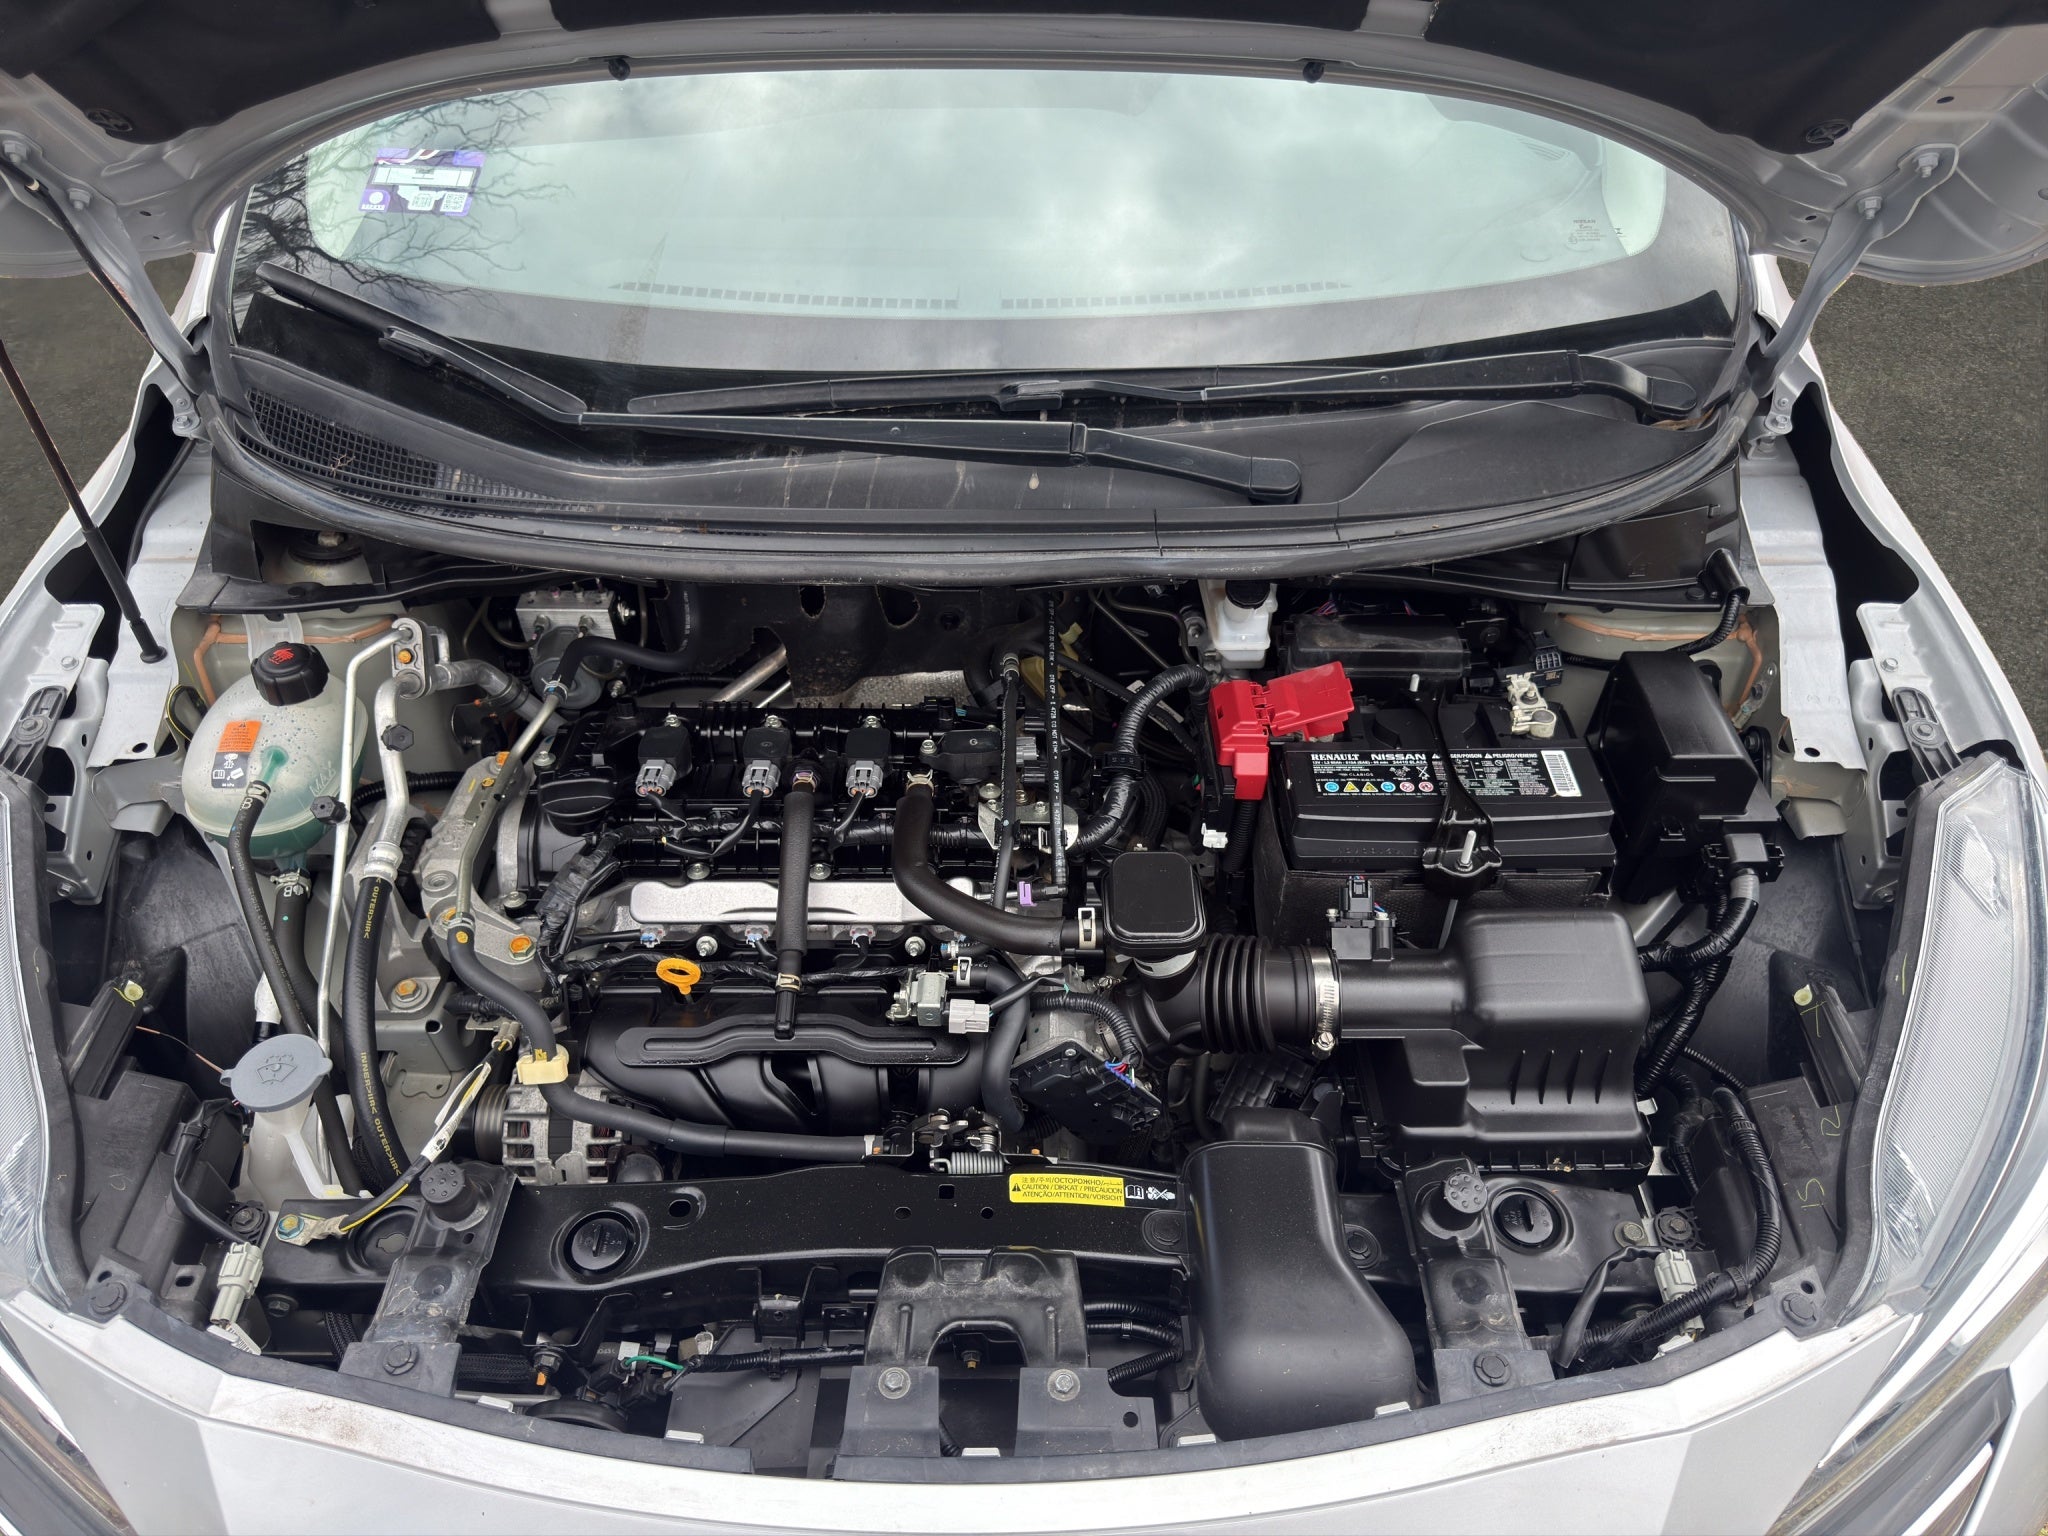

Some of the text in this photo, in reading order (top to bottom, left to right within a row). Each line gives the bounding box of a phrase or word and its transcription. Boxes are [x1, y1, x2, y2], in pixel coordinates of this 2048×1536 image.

[1311, 753, 1359, 761] RENAULT
[1371, 753, 1426, 761] NISSAN
[1054, 1184, 1078, 1192] DIKKAT
